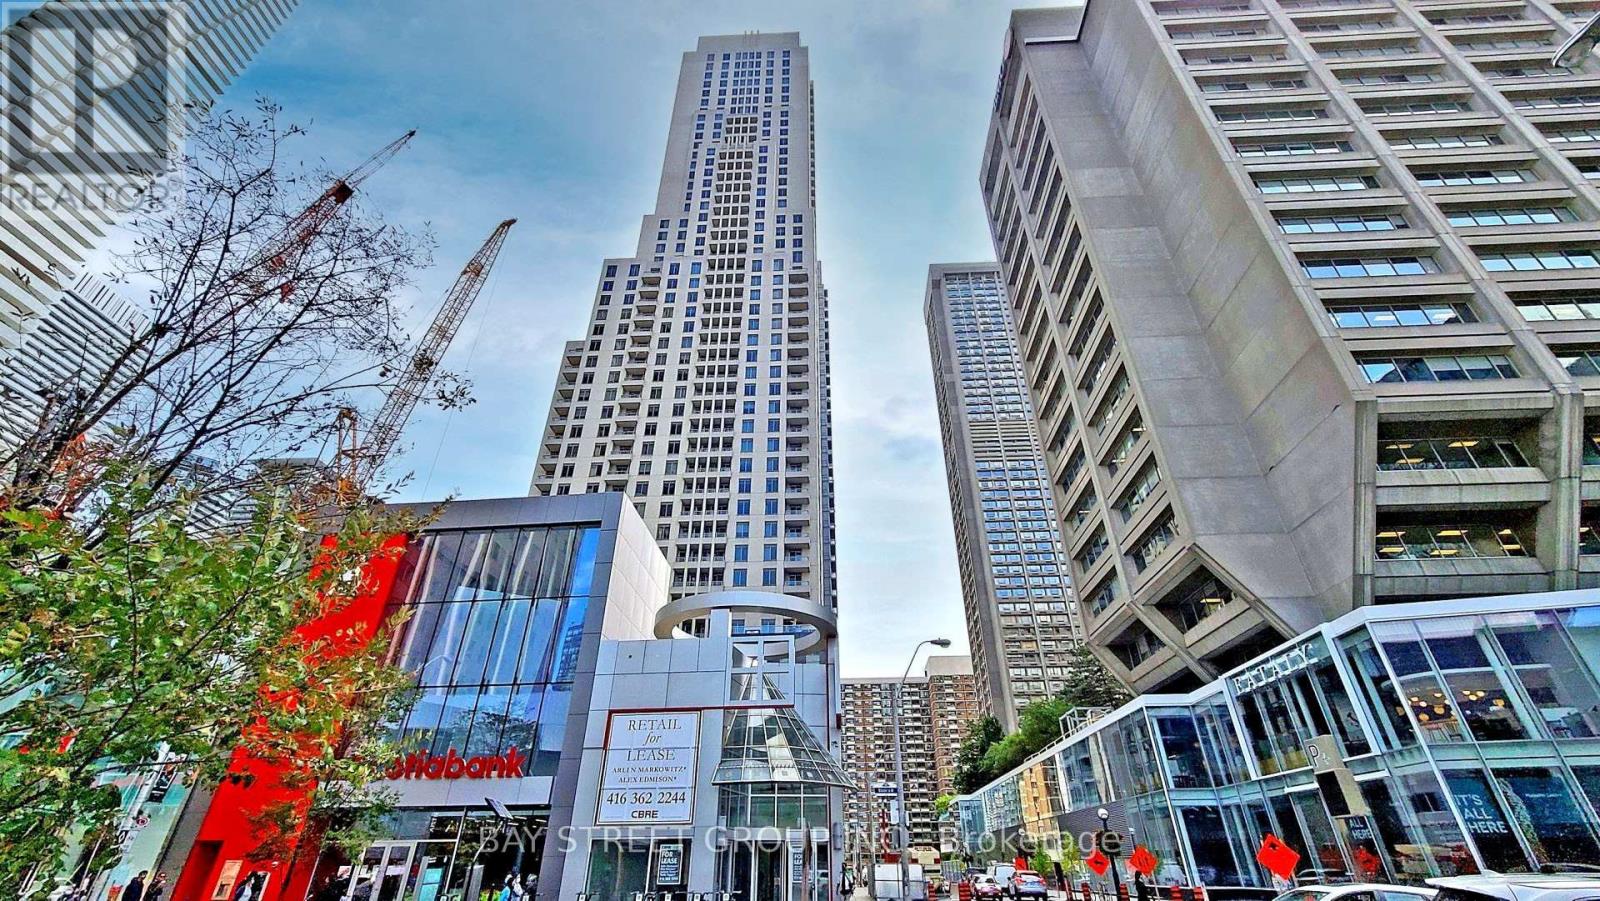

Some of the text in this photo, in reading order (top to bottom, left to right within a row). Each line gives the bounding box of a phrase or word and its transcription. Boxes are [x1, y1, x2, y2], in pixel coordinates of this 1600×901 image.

[1231, 643, 1319, 695] EATALY
[628, 718, 682, 731] RETAIL
[643, 731, 662, 746] for
[627, 749, 676, 762] LEASE
[606, 791, 686, 805] 416 362 2244
[1454, 793, 1483, 806] IT'S
[631, 810, 659, 819] CBRE
[1464, 808, 1493, 820] ALL
[1348, 818, 1364, 828] ALL
[1468, 821, 1509, 834] HERE
